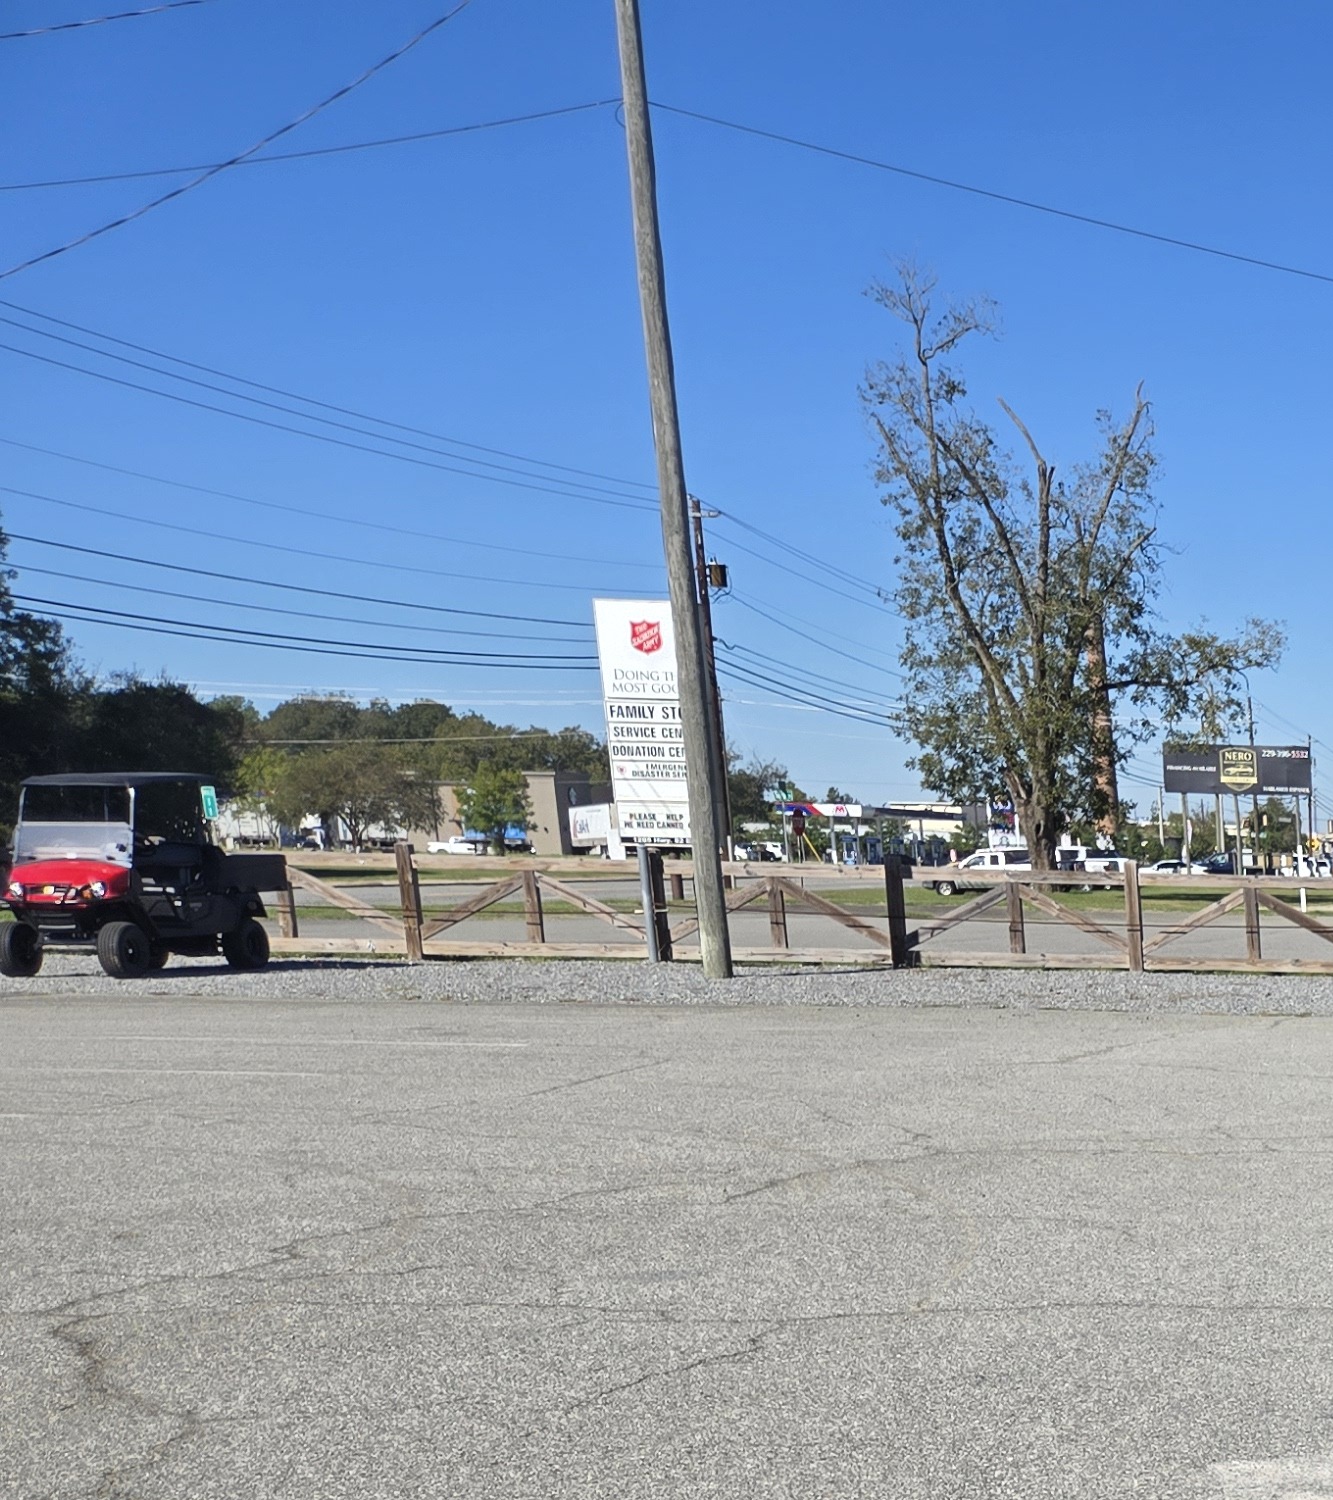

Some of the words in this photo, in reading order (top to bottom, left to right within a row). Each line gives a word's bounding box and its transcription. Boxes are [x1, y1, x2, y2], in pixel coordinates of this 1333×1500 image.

[614, 668, 660, 682] DOING
[612, 682, 648, 693] MOST
[609, 704, 655, 719] FAMILY
[613, 726, 657, 738] SERVICE
[612, 745, 665, 757] DONATION
[1225, 751, 1252, 761] NERO
[631, 770, 671, 778] DISASTER
[629, 812, 656, 821] PLEASE
[666, 813, 684, 821] HELP
[624, 820, 633, 829] WE
[636, 821, 655, 829] NEED
[656, 820, 684, 829] CANNED
